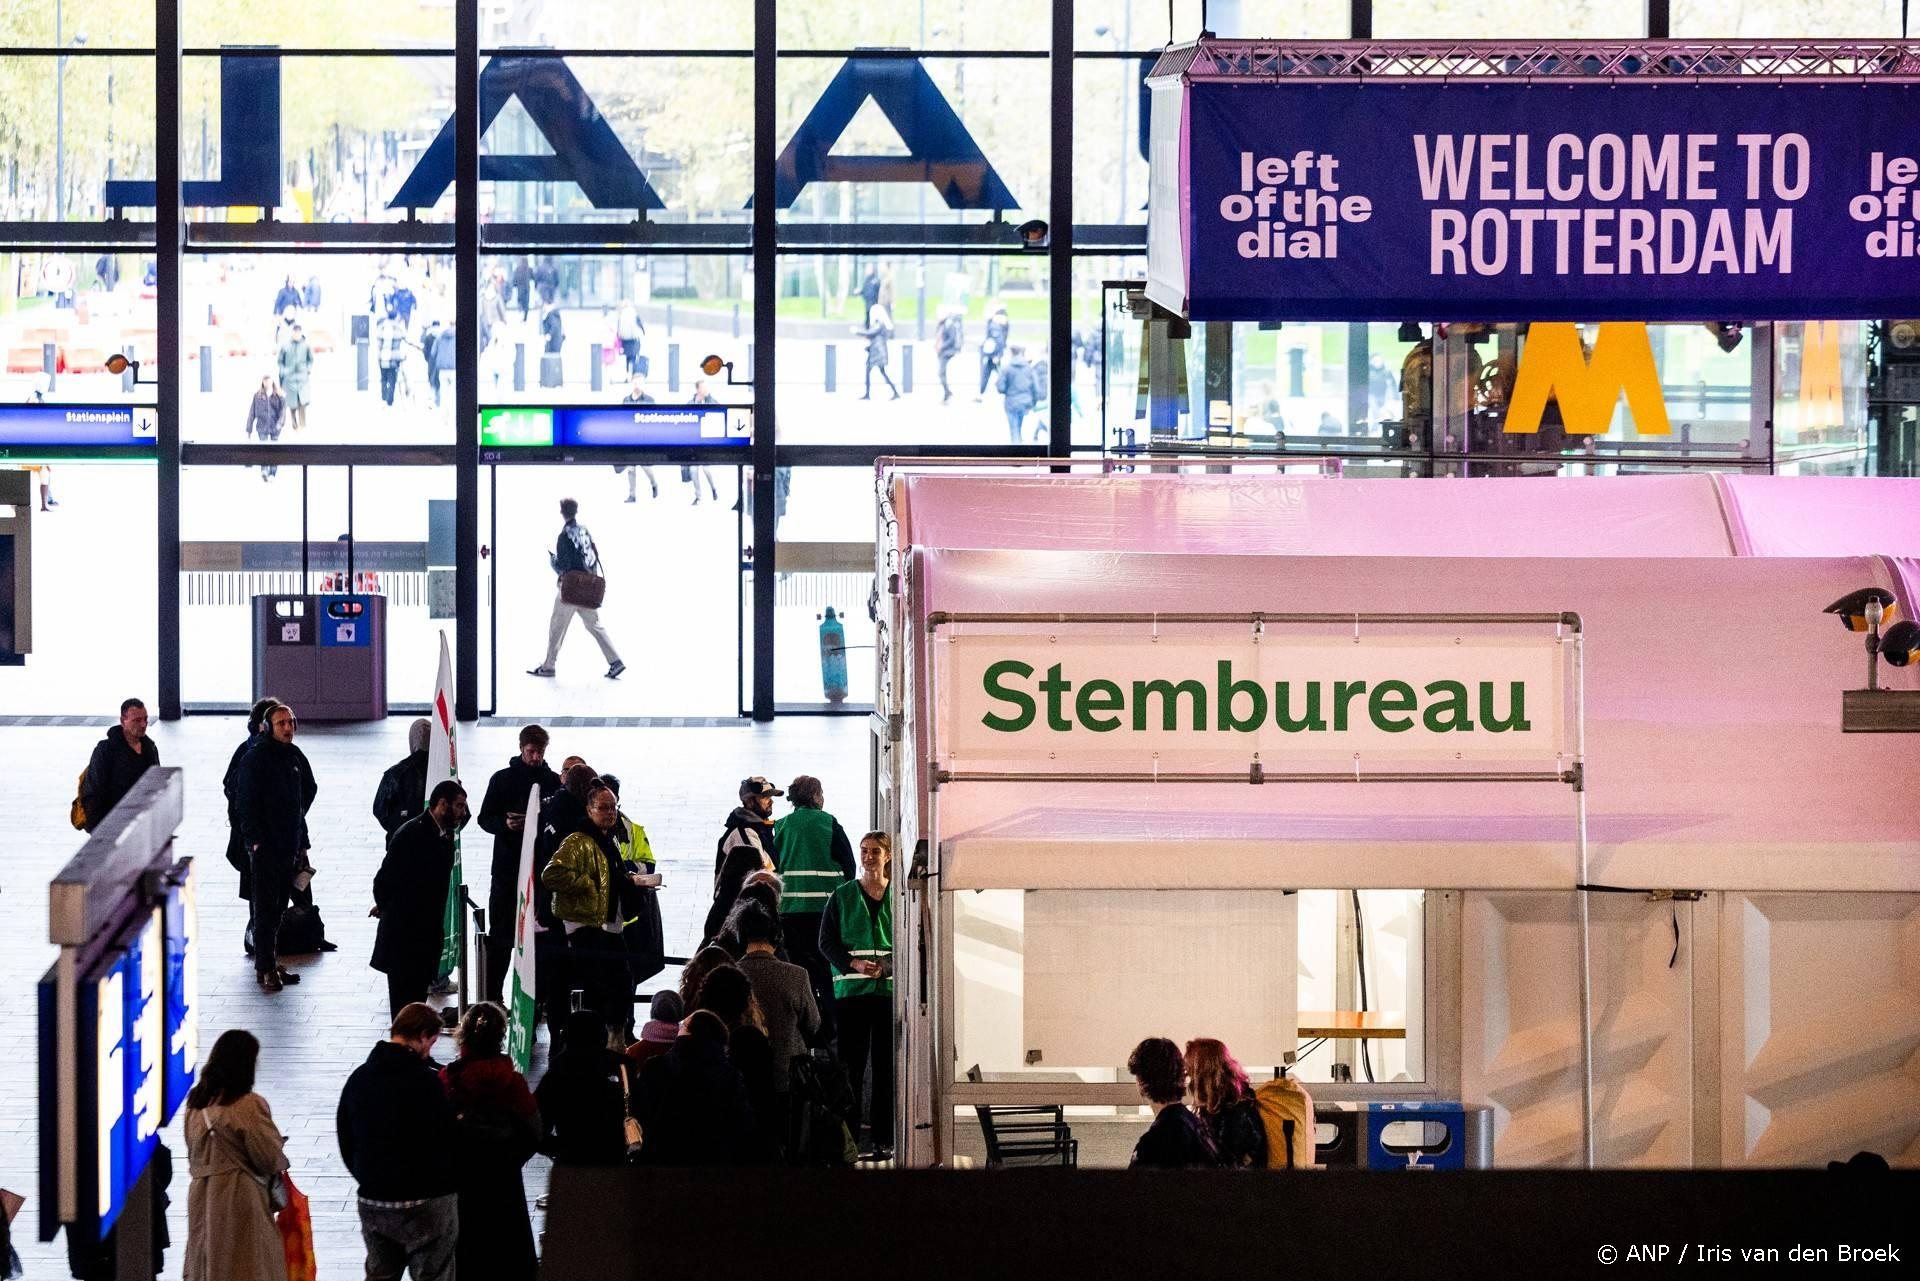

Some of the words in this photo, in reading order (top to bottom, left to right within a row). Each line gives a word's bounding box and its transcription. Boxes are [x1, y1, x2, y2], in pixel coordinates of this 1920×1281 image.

[1241, 151, 1339, 191] left
[1413, 133, 1717, 201] WELCOME
[1737, 133, 1810, 201] TO
[1870, 152, 1919, 192] le
[1237, 221, 1337, 258] dial
[1430, 208, 1793, 275] ROTTERDAM
[1866, 220, 1919, 258] di
[66, 411, 130, 424] Stationsplein
[634, 412, 699, 425] Stationsplein
[981, 660, 1531, 732] Stembureau
